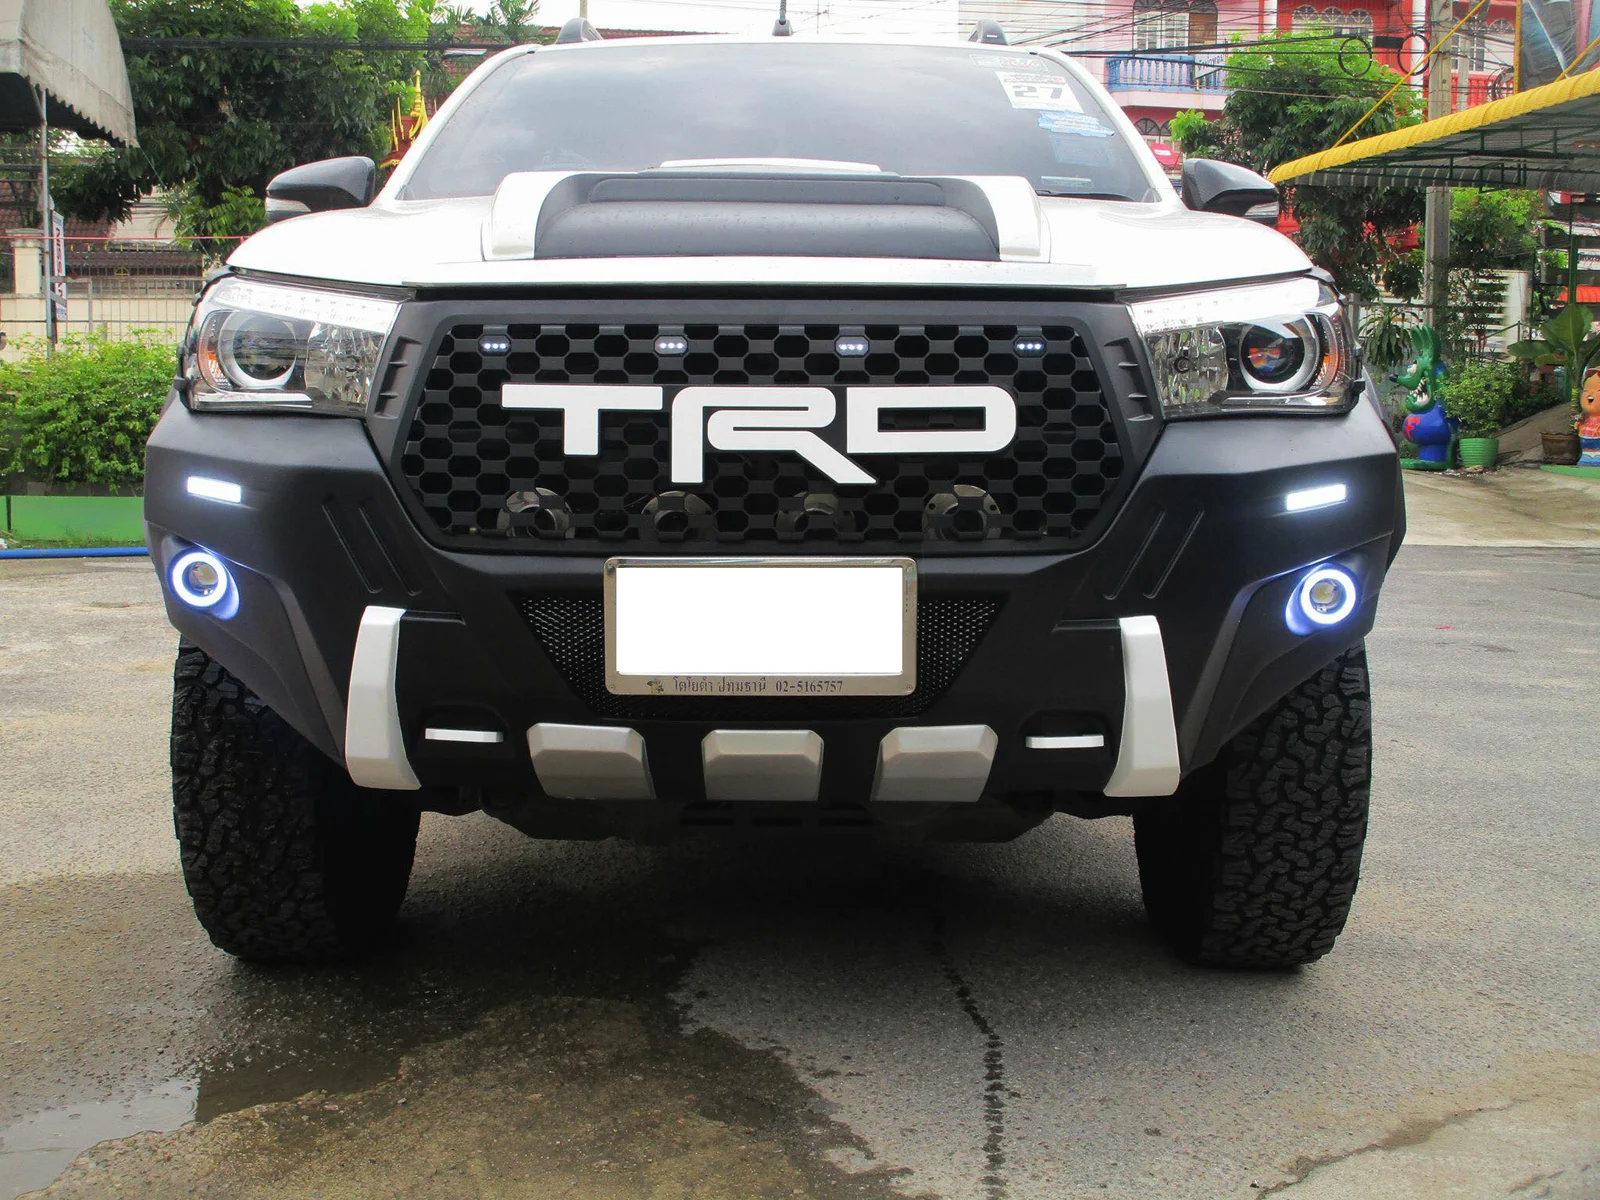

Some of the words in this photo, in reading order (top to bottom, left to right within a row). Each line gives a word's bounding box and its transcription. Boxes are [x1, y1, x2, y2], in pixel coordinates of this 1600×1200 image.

[1012, 85, 1063, 99] 27
[501, 384, 1017, 484] TRD
[718, 676, 766, 694] ปทุมธานี
[776, 680, 843, 692] 02-5165757
